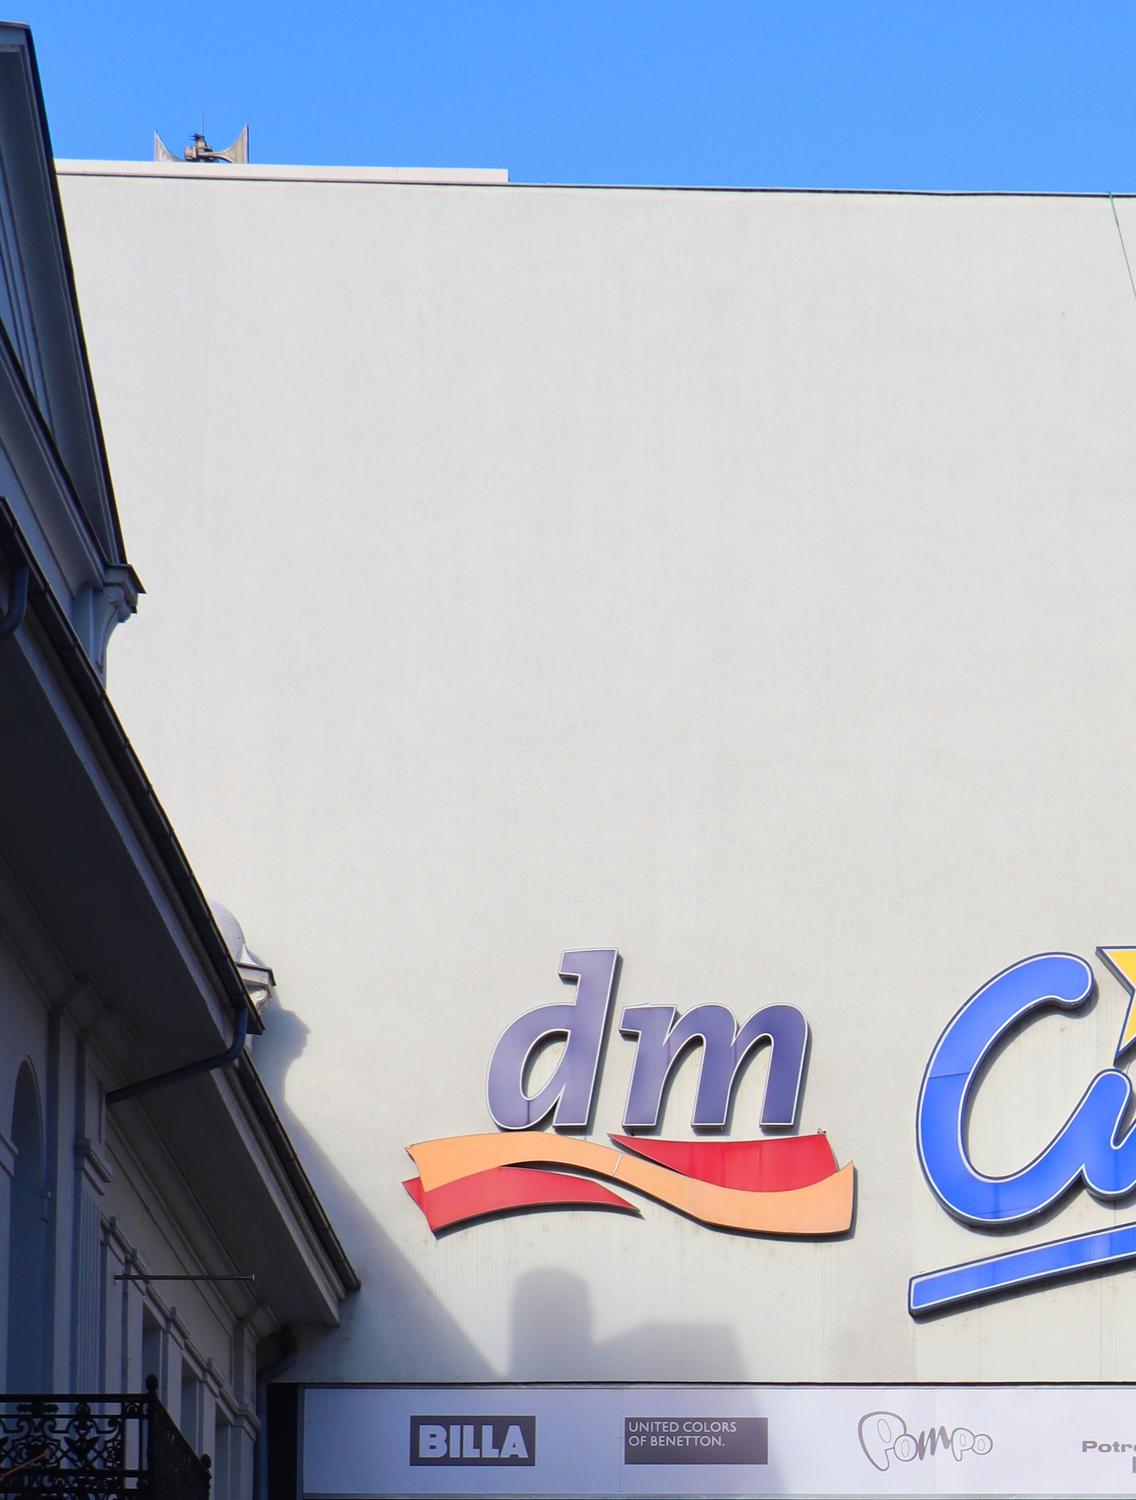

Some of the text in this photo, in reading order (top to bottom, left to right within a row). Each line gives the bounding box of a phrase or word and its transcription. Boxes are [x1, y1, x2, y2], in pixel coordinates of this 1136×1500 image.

[486, 947, 813, 1132] dm
[419, 1424, 529, 1458] BILLA
[629, 1421, 738, 1433] UNITED COLORS
[629, 1435, 726, 1447] OF BENETTON.
[857, 1410, 993, 1471] Pompo
